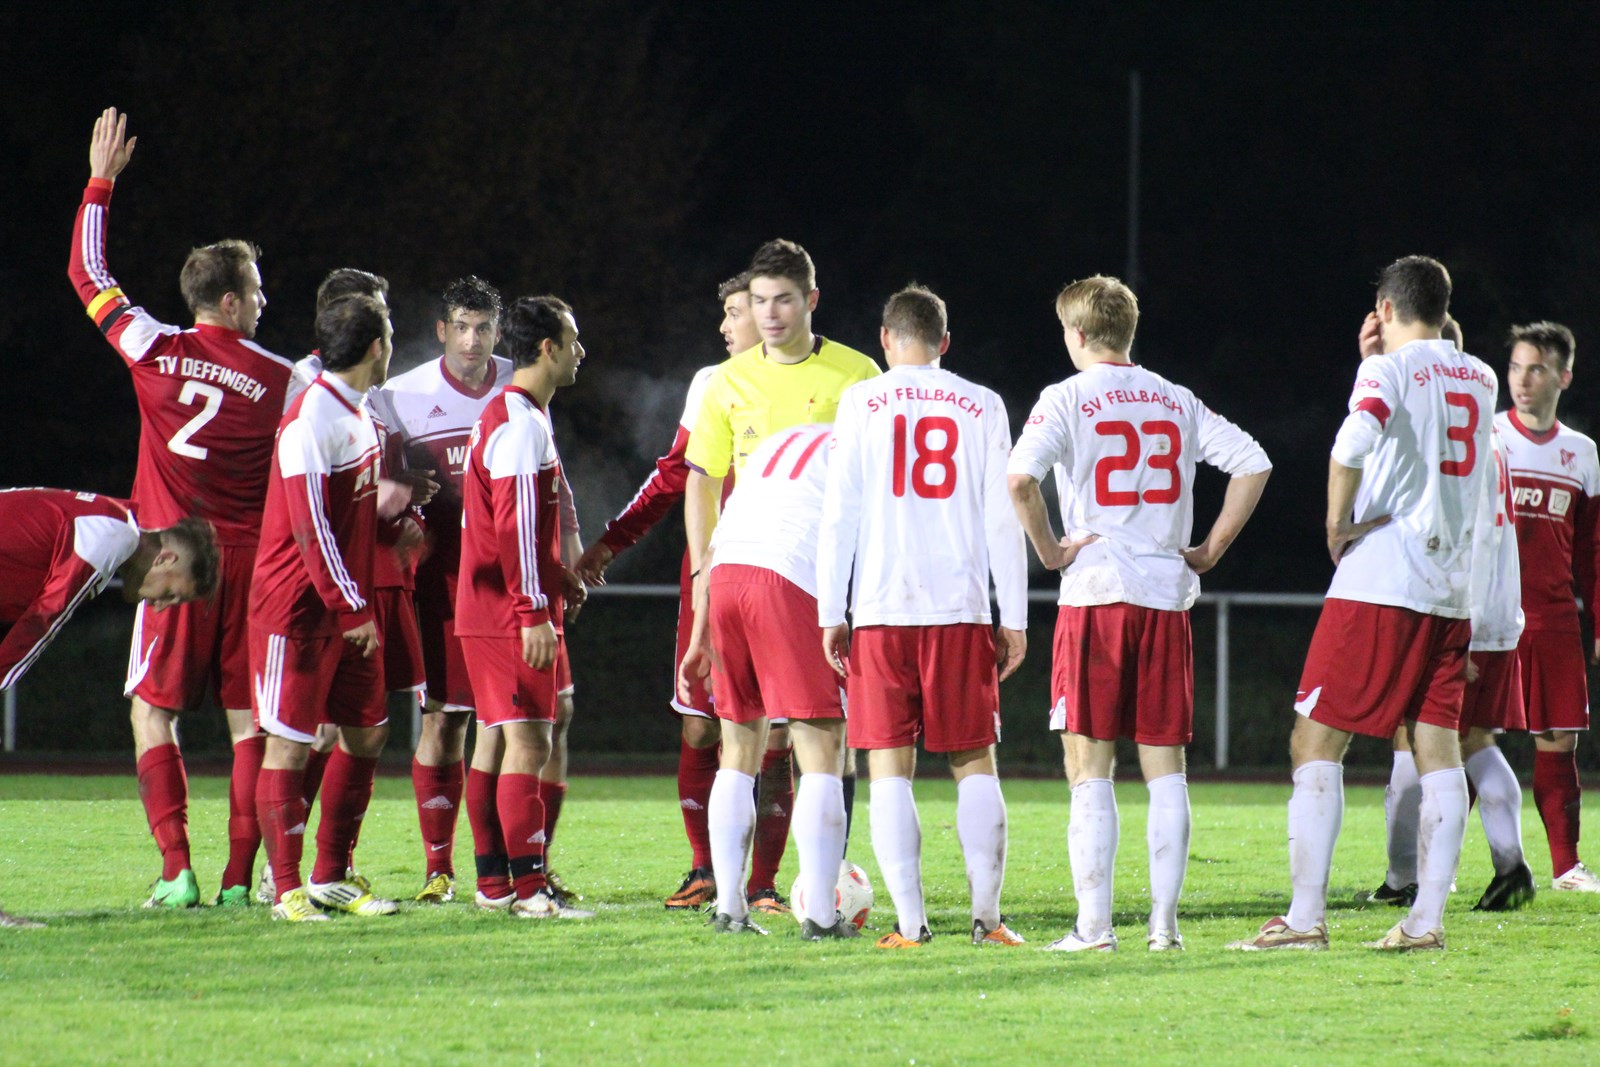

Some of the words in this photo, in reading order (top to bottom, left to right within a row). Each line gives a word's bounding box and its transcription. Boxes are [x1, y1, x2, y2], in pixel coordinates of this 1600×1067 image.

[155, 356, 178, 375] TV
[1413, 366, 1431, 387] SV
[167, 379, 224, 461] 2
[867, 392, 888, 412] SV
[895, 387, 983, 418] FELLBACH
[1081, 397, 1102, 418] SV
[1105, 389, 1183, 415] FELLBACH
[892, 414, 959, 499] 18
[1439, 391, 1480, 477] 3
[1095, 420, 1182, 507] 23
